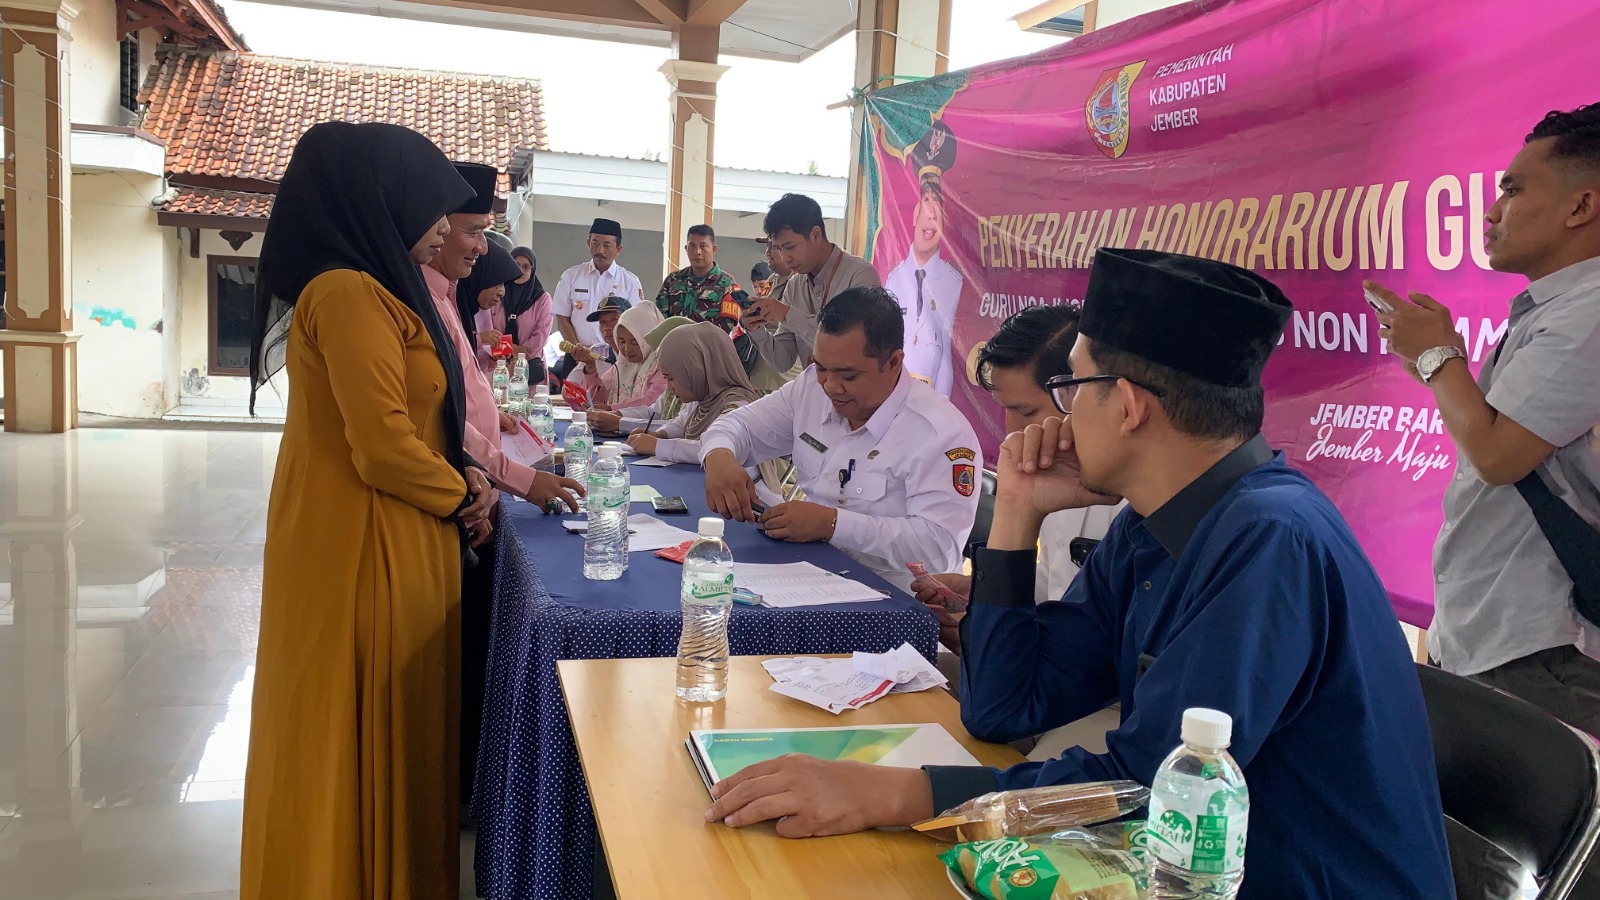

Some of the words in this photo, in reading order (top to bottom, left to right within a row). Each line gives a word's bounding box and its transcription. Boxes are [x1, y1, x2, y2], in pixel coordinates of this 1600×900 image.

[1152, 43, 1235, 79] PEMERINTAH
[1150, 73, 1227, 106] KABUPATEN
[1151, 108, 1199, 132] JEMBER
[977, 207, 1137, 269] PENYERAHAN
[1136, 180, 1409, 271] HONORARIUM
[979, 292, 1016, 318] GURU
[1293, 310, 1368, 353] NON
[1310, 403, 1394, 430] JEMBER
[1305, 424, 1384, 463] Jember
[1386, 428, 1451, 481] Maju
